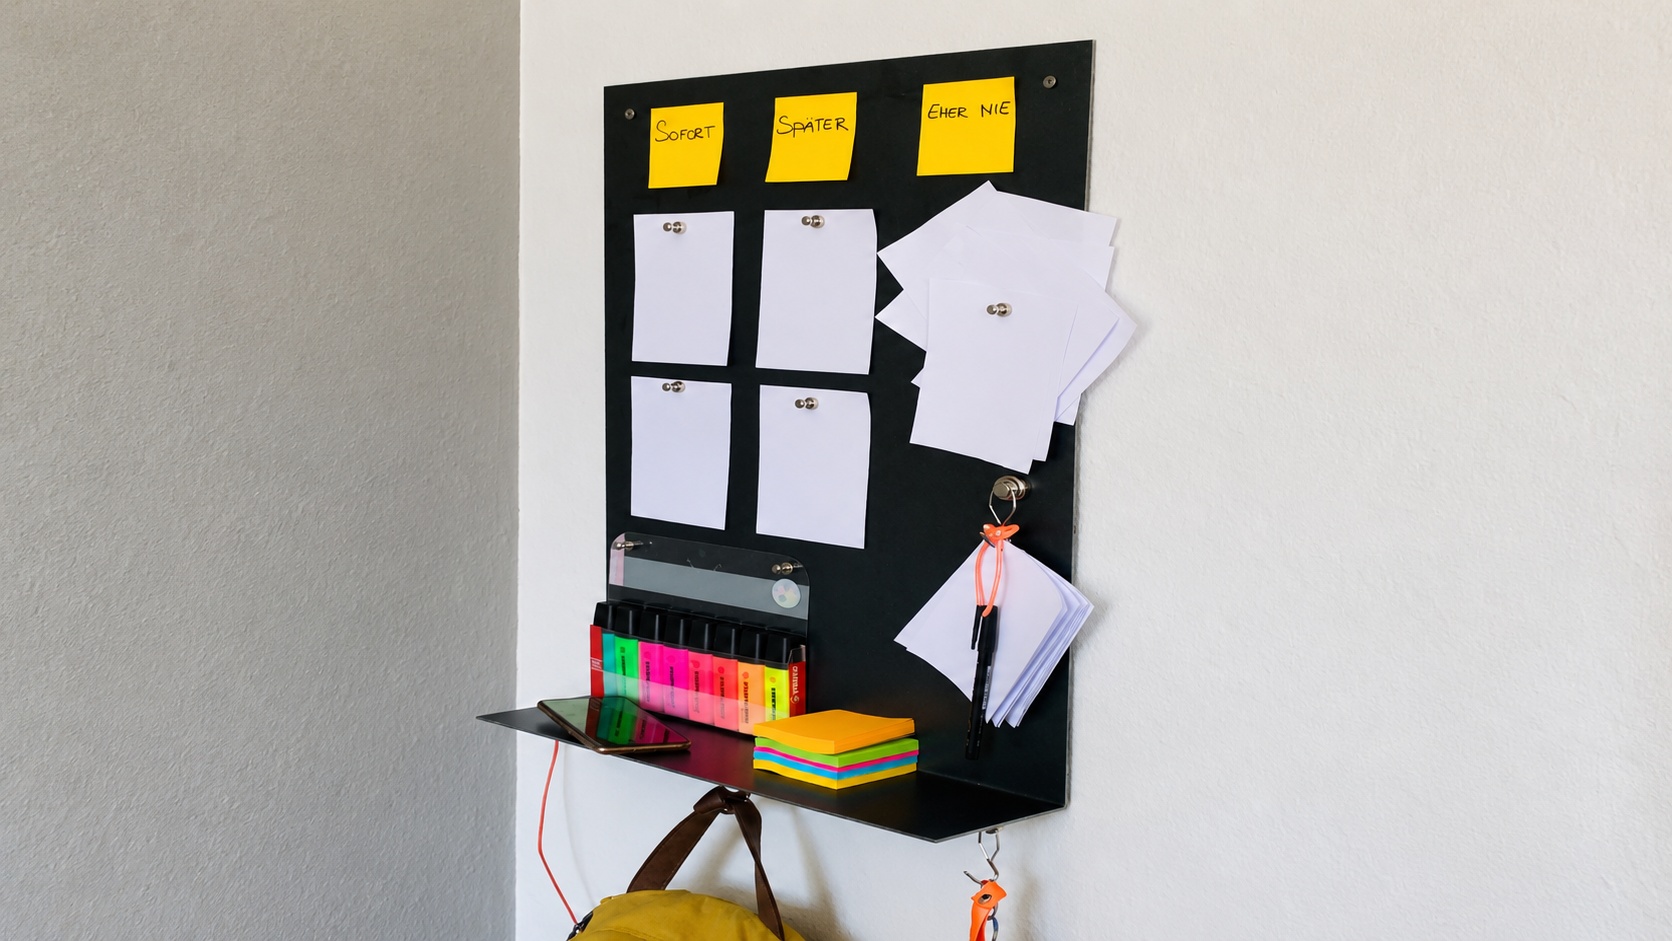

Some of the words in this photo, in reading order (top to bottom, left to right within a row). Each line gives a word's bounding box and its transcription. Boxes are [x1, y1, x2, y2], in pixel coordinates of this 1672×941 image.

[927, 102, 968, 120] EHER
[980, 100, 1011, 117] NIE
[654, 120, 716, 142] SOFORT
[776, 115, 849, 138] SPÄTER
